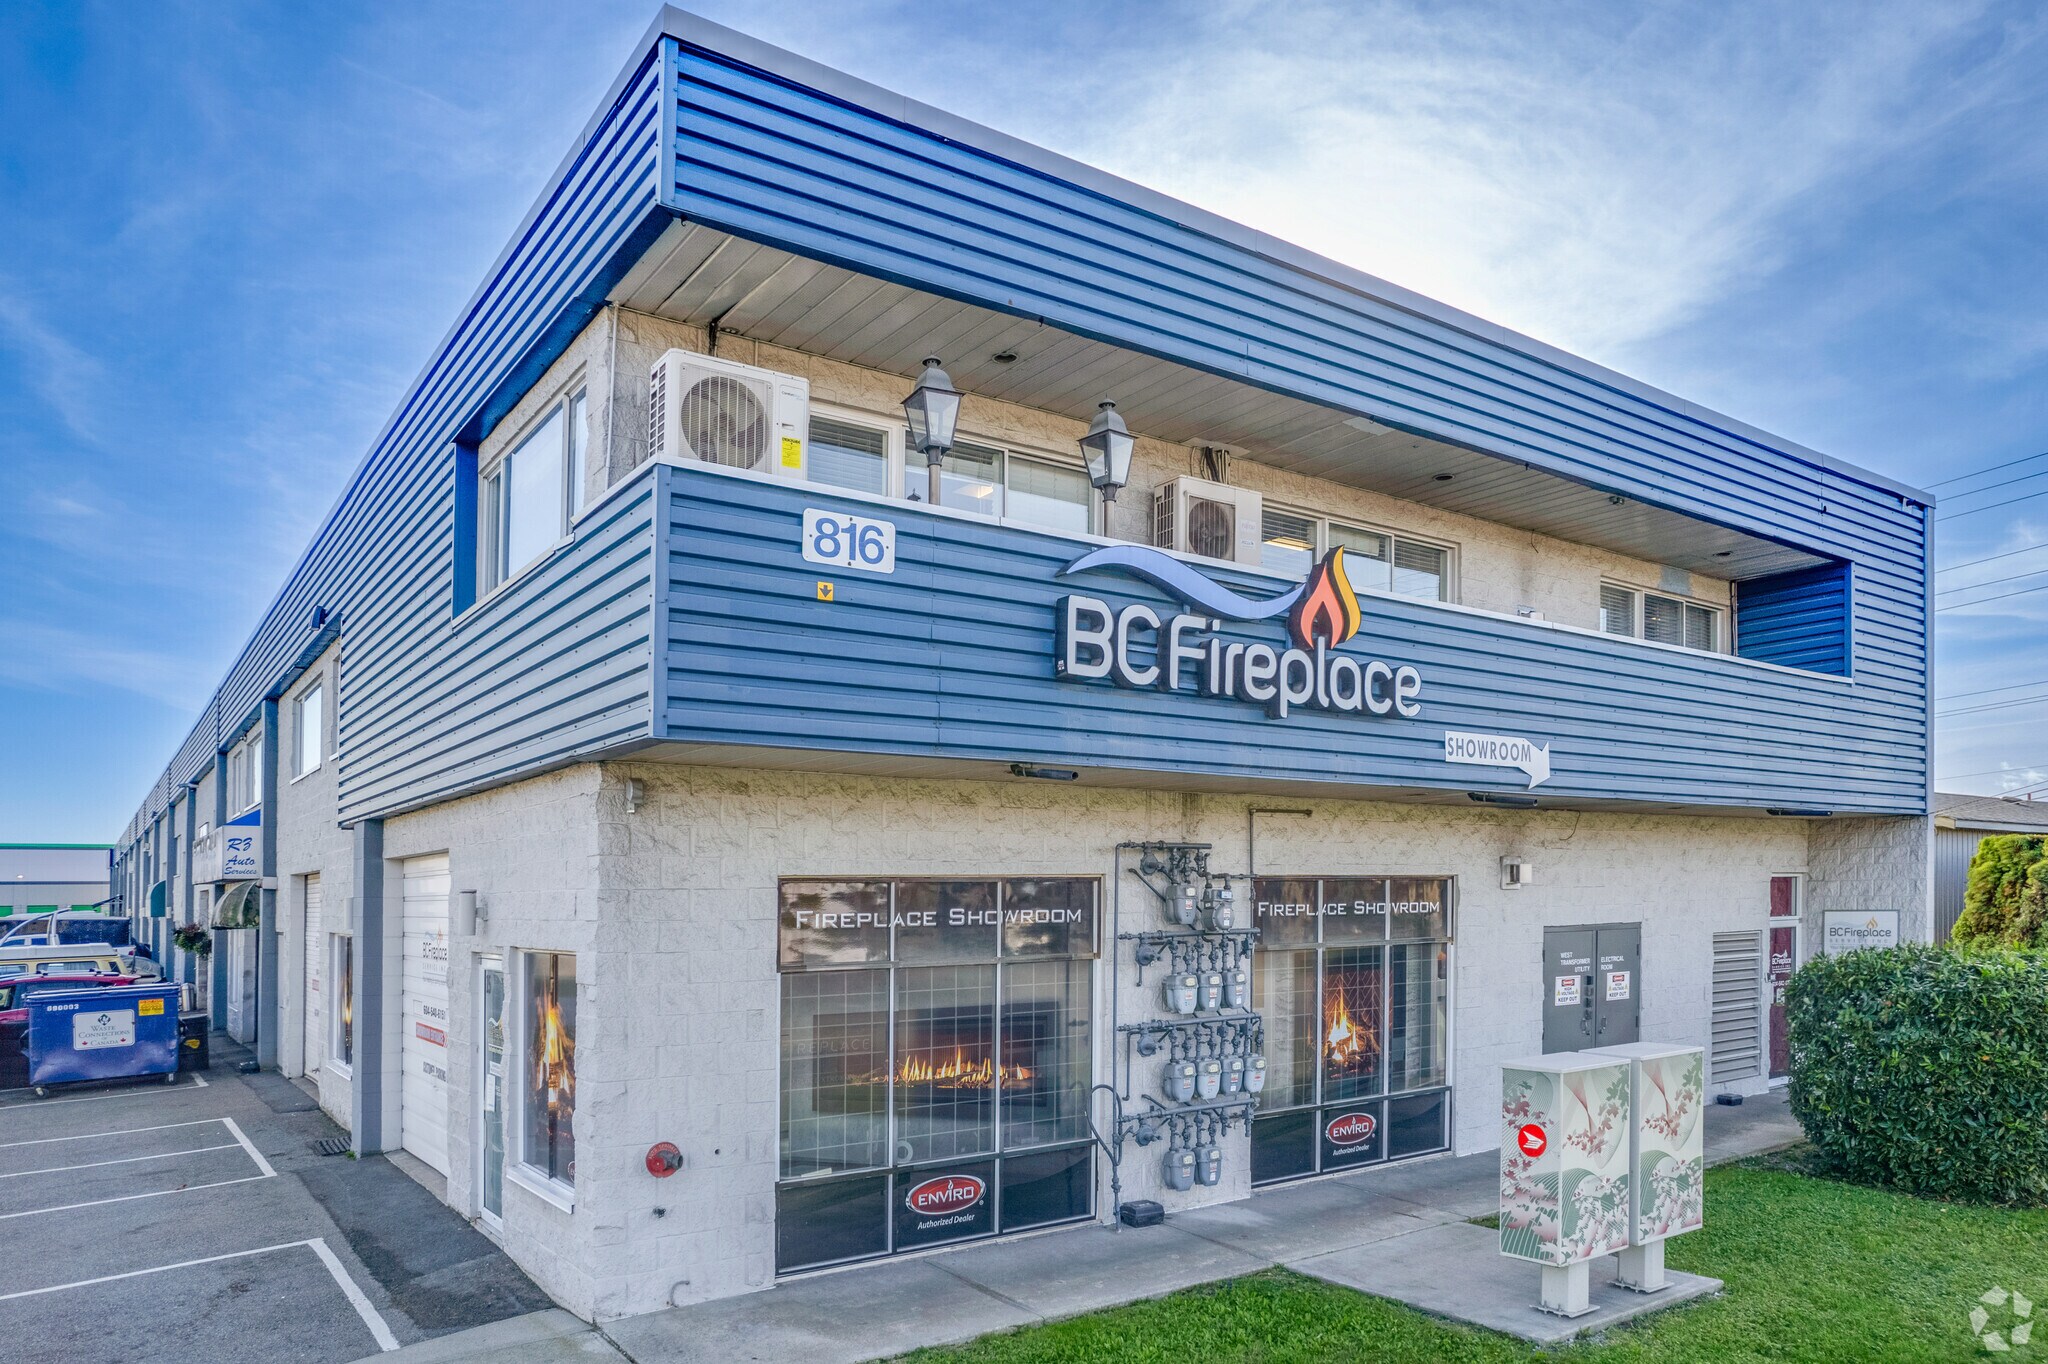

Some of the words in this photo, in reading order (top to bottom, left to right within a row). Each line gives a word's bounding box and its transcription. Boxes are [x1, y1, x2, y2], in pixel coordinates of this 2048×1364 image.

[813, 517, 885, 565] 816
[1060, 594, 1423, 719] BCFireplace
[1447, 737, 1532, 763] SHOWROOM
[225, 854, 256, 866] Auto
[1560, 958, 1591, 966] TRANSFORMER
[1600, 955, 1625, 963] ELECTRICAL
[1574, 965, 1591, 973] UTILITY
[78, 1030, 131, 1039] CONNECTIONS
[90, 1039, 119, 1047] CANADA
[1333, 1122, 1370, 1137] ENVIRO
[918, 1186, 975, 1207] ENVIRO
[917, 1217, 954, 1230] Authorized
[953, 1213, 976, 1224] Dealer
